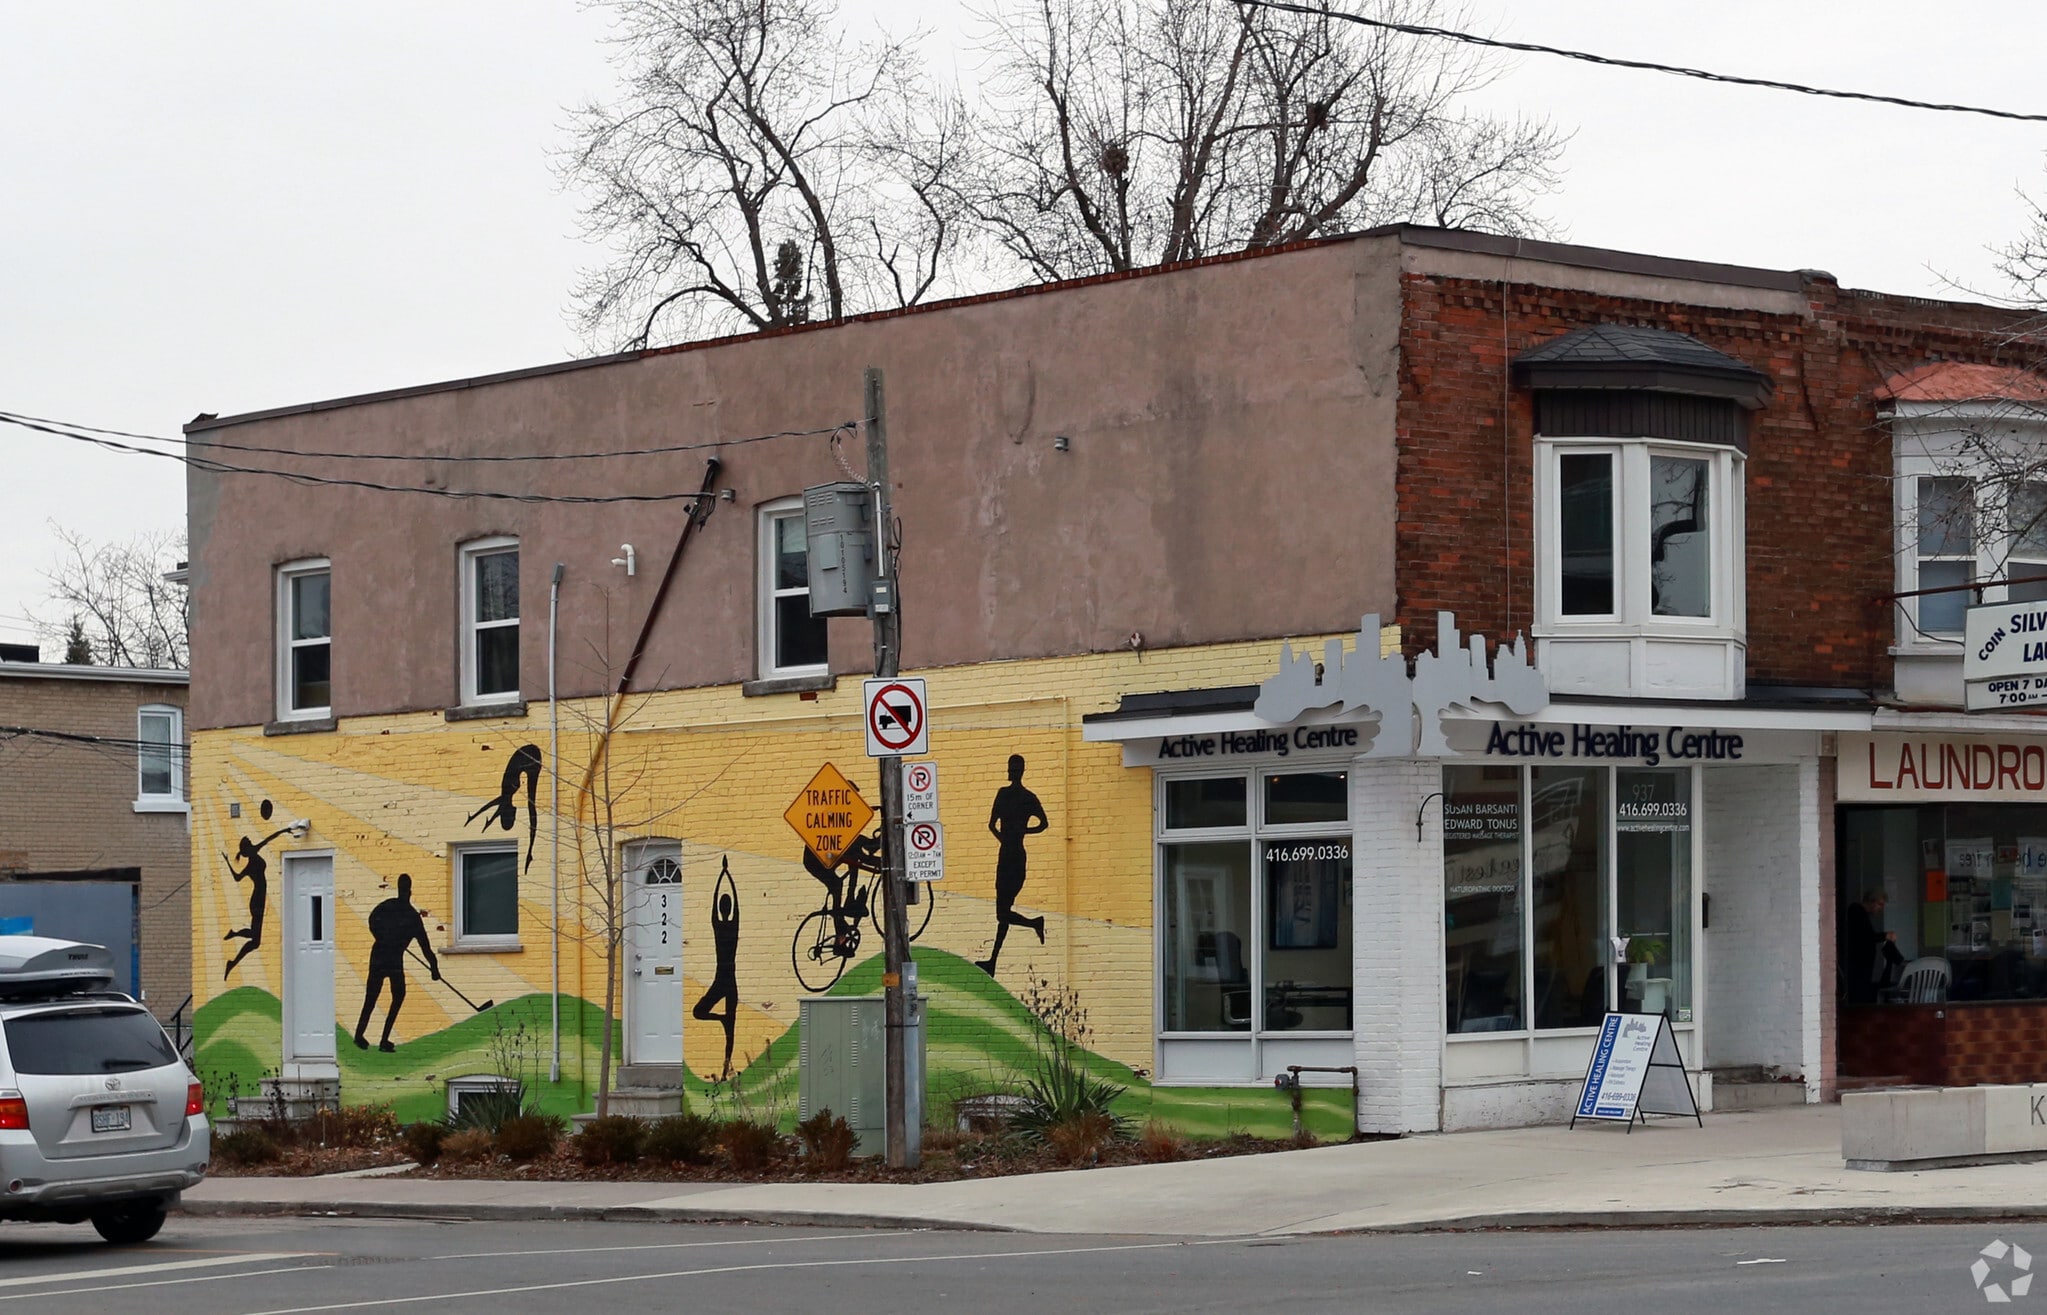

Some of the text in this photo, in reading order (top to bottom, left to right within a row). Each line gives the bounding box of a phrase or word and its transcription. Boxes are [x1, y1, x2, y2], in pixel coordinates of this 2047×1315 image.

[2010, 611, 2047, 633] SILV
[1978, 627, 2006, 661] COIN
[2023, 641, 2047, 662] LA
[1988, 680, 2018, 692] OPEN
[2023, 679, 2030, 690] 7
[1159, 726, 1358, 758] Active Healing Centre
[1486, 720, 1744, 766] Active Healing Centre
[1869, 742, 2045, 790] LAUNDRO
[806, 789, 852, 806] TRAFFIC
[925, 792, 934, 801] OF
[1632, 784, 1655, 801] 937
[908, 801, 934, 810] CORNER
[1444, 803, 1518, 814] SUSAN BARSANTI
[1619, 802, 1687, 816] 416.699.0336
[806, 811, 853, 828] CALMING
[1444, 818, 1518, 829] EDWARD TONUS
[816, 834, 842, 851] ZONE
[1265, 845, 1349, 862] 416.699.0336
[913, 860, 937, 869] EXCEPT
[909, 869, 942, 879] BY PERMIT
[1492, 885, 1515, 893] DOCTOR
[1583, 1016, 1619, 1114] ACTIVE HEALING CENTRE
